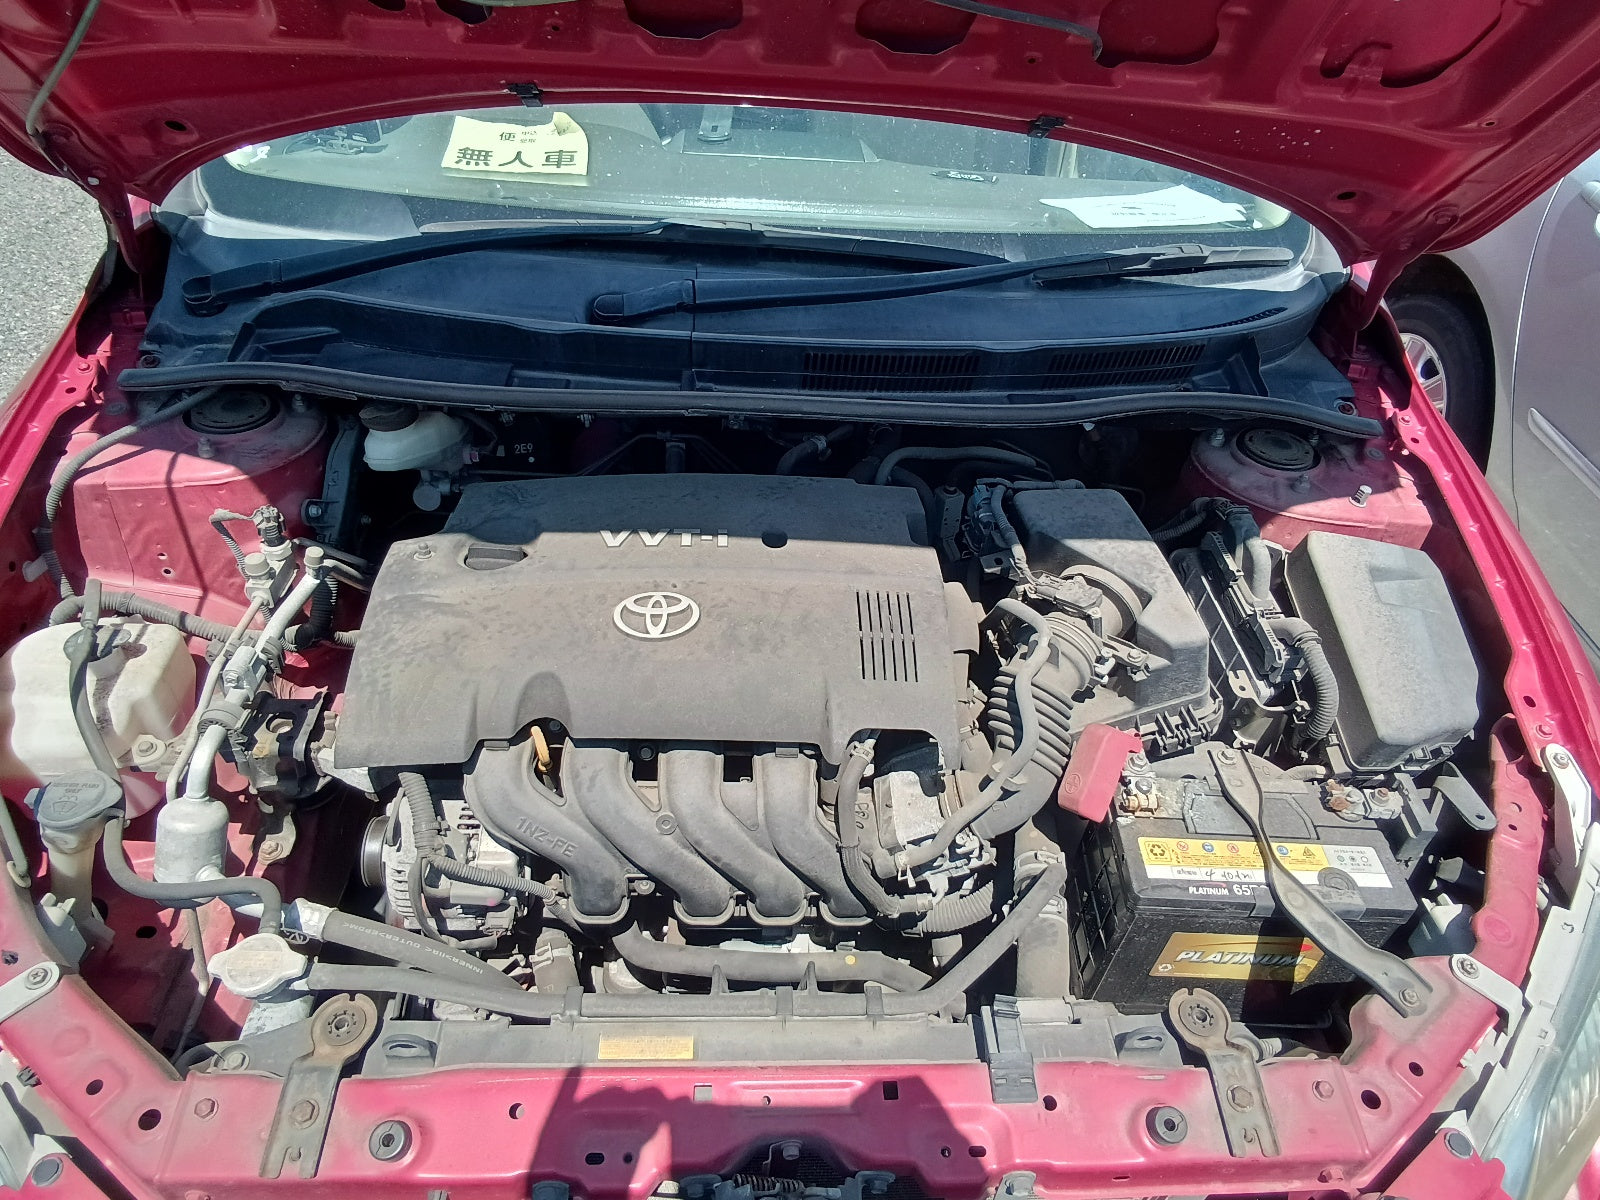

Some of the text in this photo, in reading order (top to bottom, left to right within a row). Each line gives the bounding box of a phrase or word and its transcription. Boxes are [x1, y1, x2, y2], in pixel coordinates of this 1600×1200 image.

[454, 147, 578, 169] 無人車
[514, 443, 534, 454] 2E9
[600, 528, 729, 548] VVT-i
[516, 816, 579, 858] 1NZ-FE
[1188, 884, 1268, 896] PLATINUM 65
[1173, 950, 1305, 967] PLATINUM
